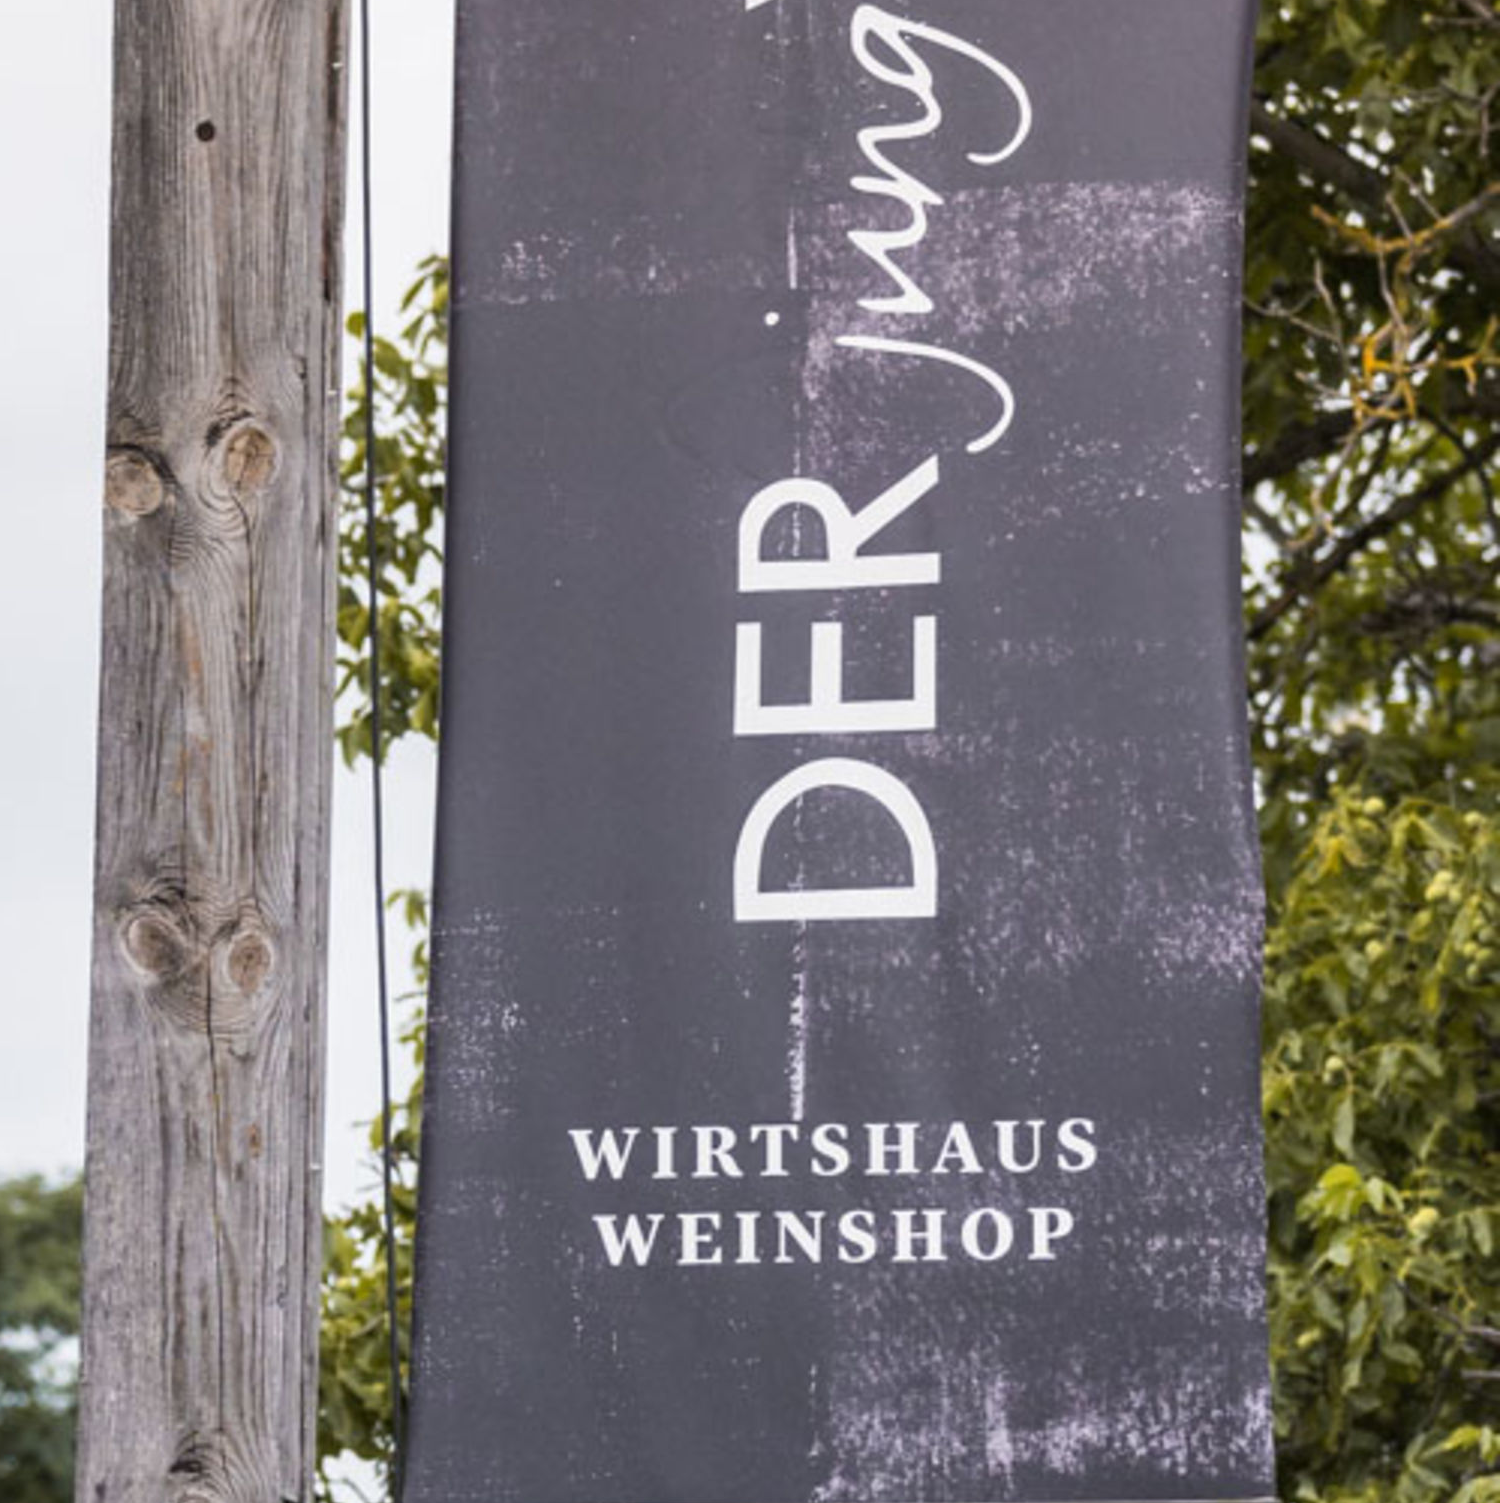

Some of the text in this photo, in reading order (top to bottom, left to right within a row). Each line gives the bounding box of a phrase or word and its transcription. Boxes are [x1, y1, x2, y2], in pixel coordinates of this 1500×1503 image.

[764, 3, 1033, 453] jung
[733, 454, 941, 922] DER
[567, 1117, 1097, 1181] WIRTSHAUS
[592, 1206, 1074, 1267] WEINSHOP
